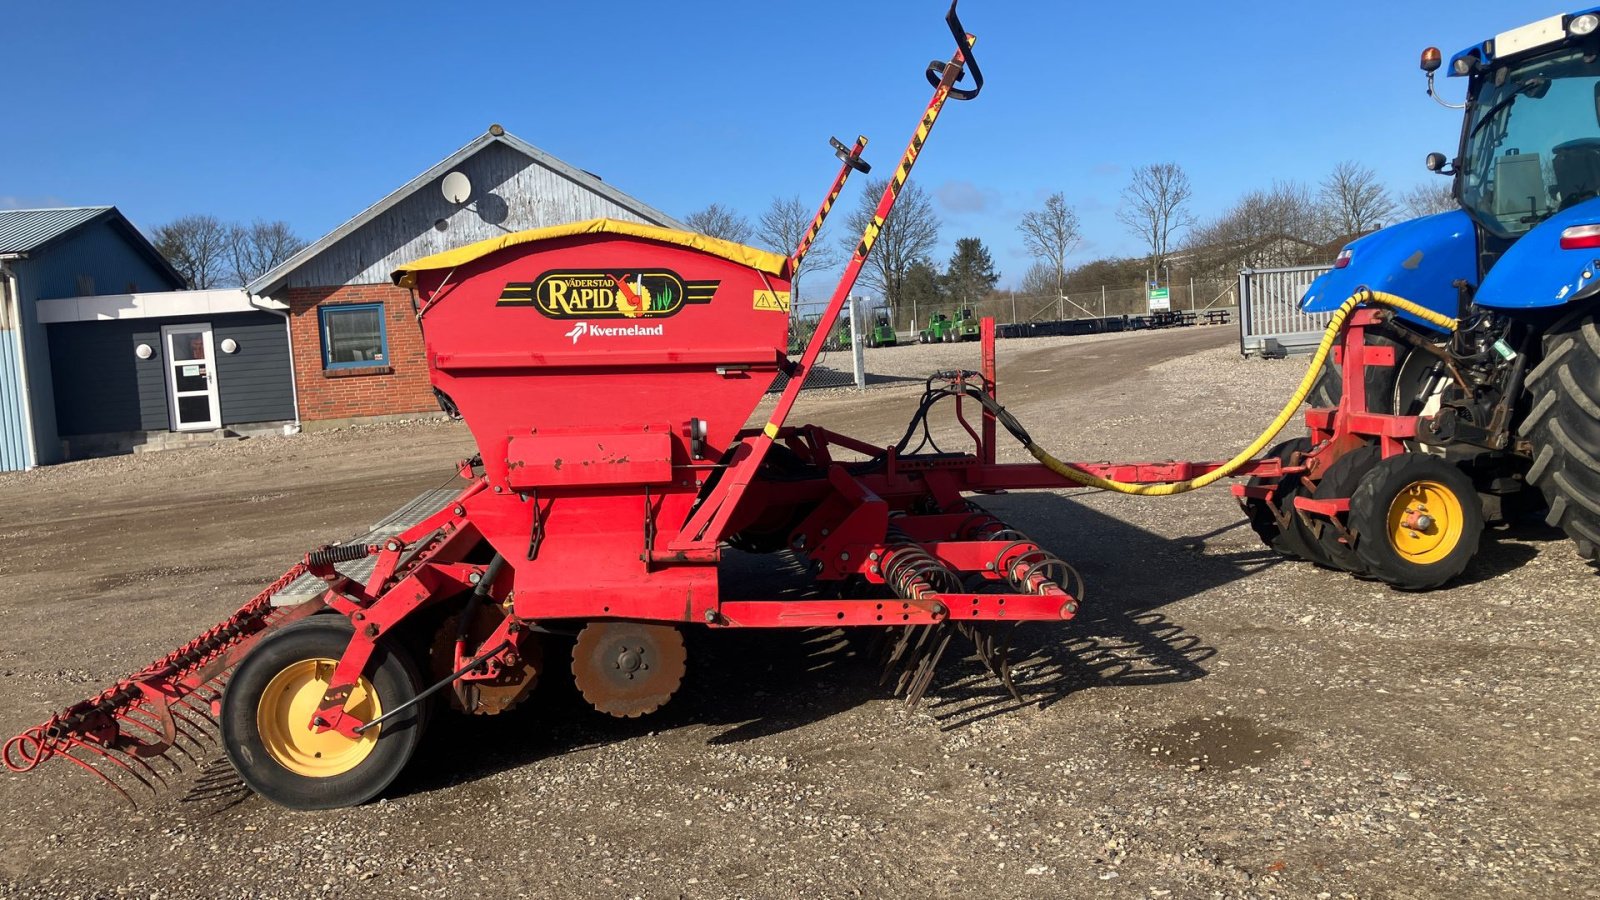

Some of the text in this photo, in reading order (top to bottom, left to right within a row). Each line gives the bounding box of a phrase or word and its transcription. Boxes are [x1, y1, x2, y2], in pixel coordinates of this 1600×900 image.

[564, 278, 614, 287] VÄDERSTAD
[547, 280, 614, 314] RAPID
[589, 324, 663, 336] Kverneland
